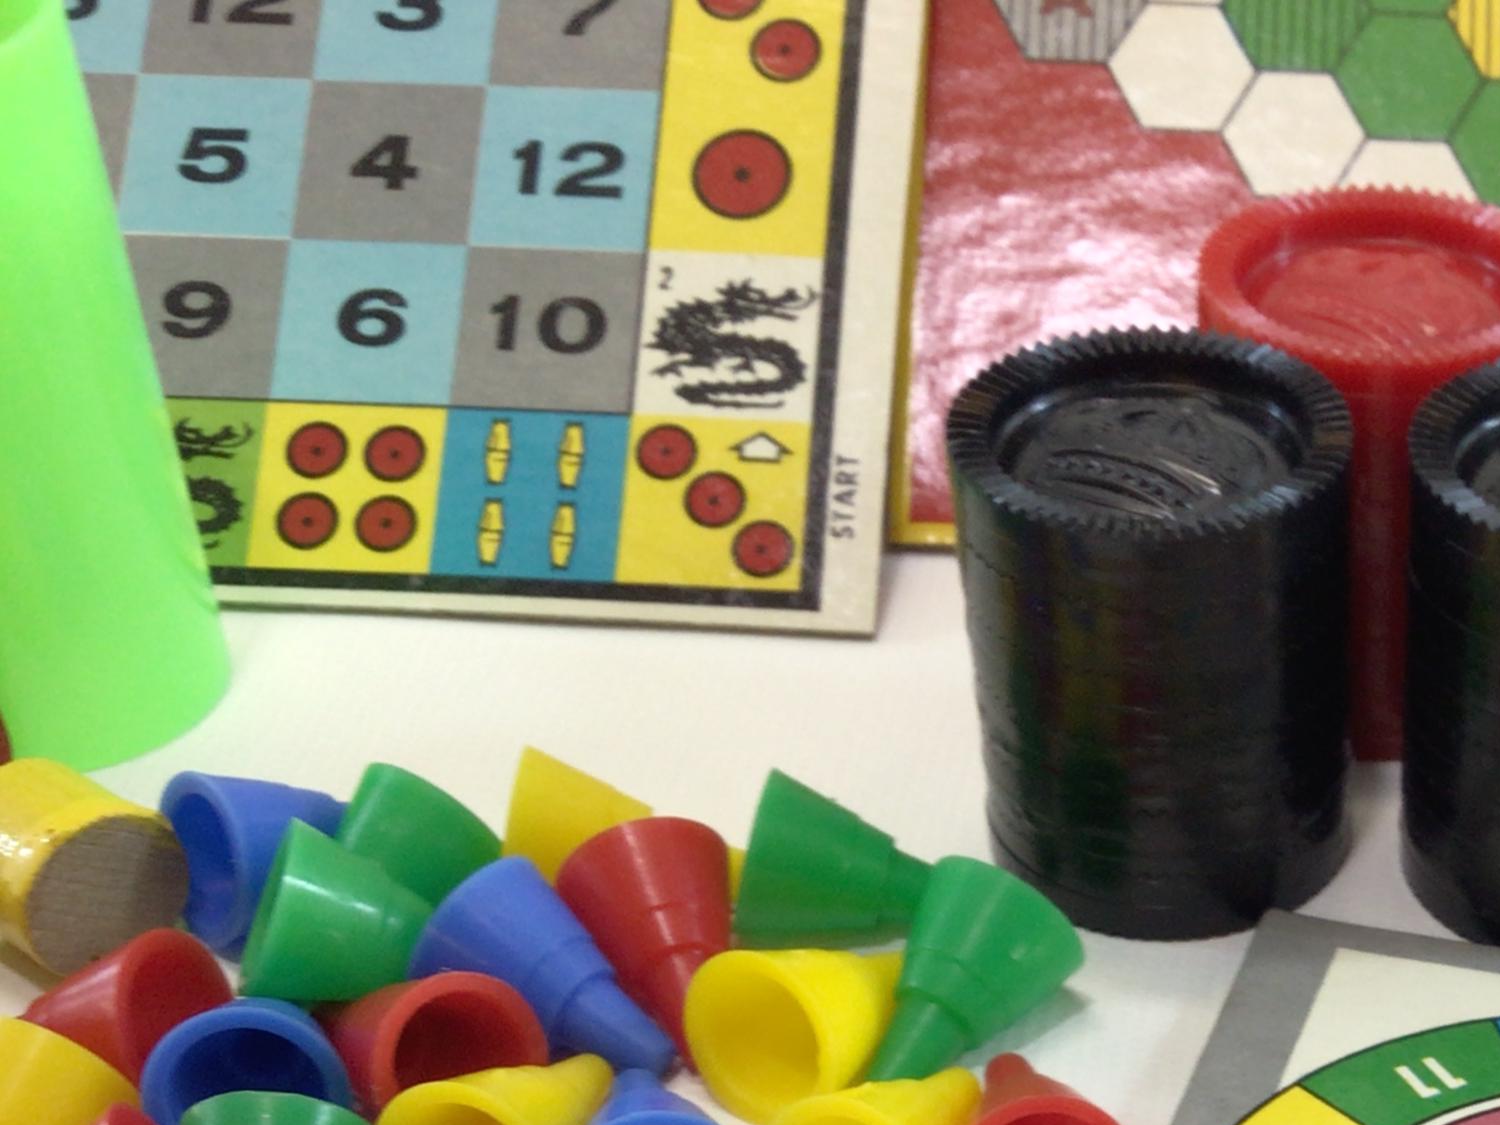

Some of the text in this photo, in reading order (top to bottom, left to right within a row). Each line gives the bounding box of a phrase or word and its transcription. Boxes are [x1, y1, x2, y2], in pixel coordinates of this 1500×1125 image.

[177, 127, 251, 184] 5
[350, 135, 420, 190] 4
[513, 140, 626, 199] 12
[162, 280, 232, 338] 9
[336, 288, 408, 347] 6
[491, 294, 608, 354] 10
[829, 454, 860, 539] START
[1394, 1056, 1468, 1098] 11
